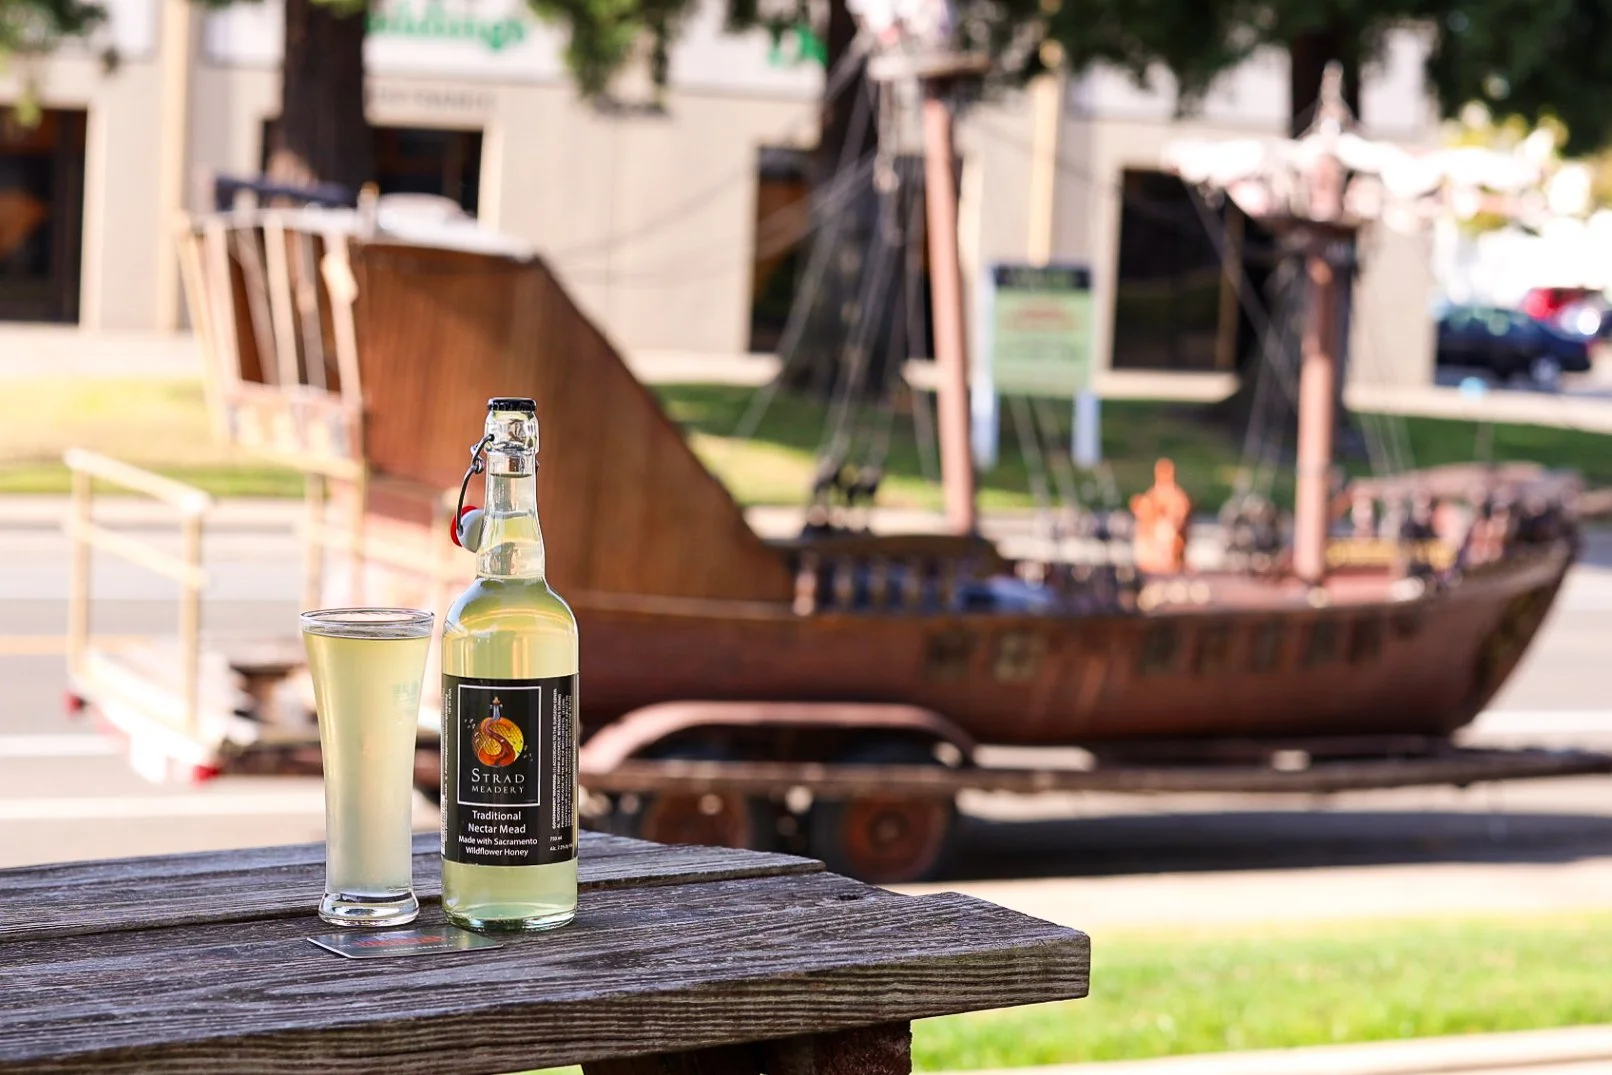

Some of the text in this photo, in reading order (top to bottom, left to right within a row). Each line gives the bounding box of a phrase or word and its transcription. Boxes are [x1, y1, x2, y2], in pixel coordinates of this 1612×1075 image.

[471, 785, 524, 794] MEADERY
[472, 810, 522, 821] Traditional
[468, 823, 526, 834] Nectar Mead
[458, 835, 538, 846] Made with Sacramento
[465, 846, 529, 858] Wildflower Honey
